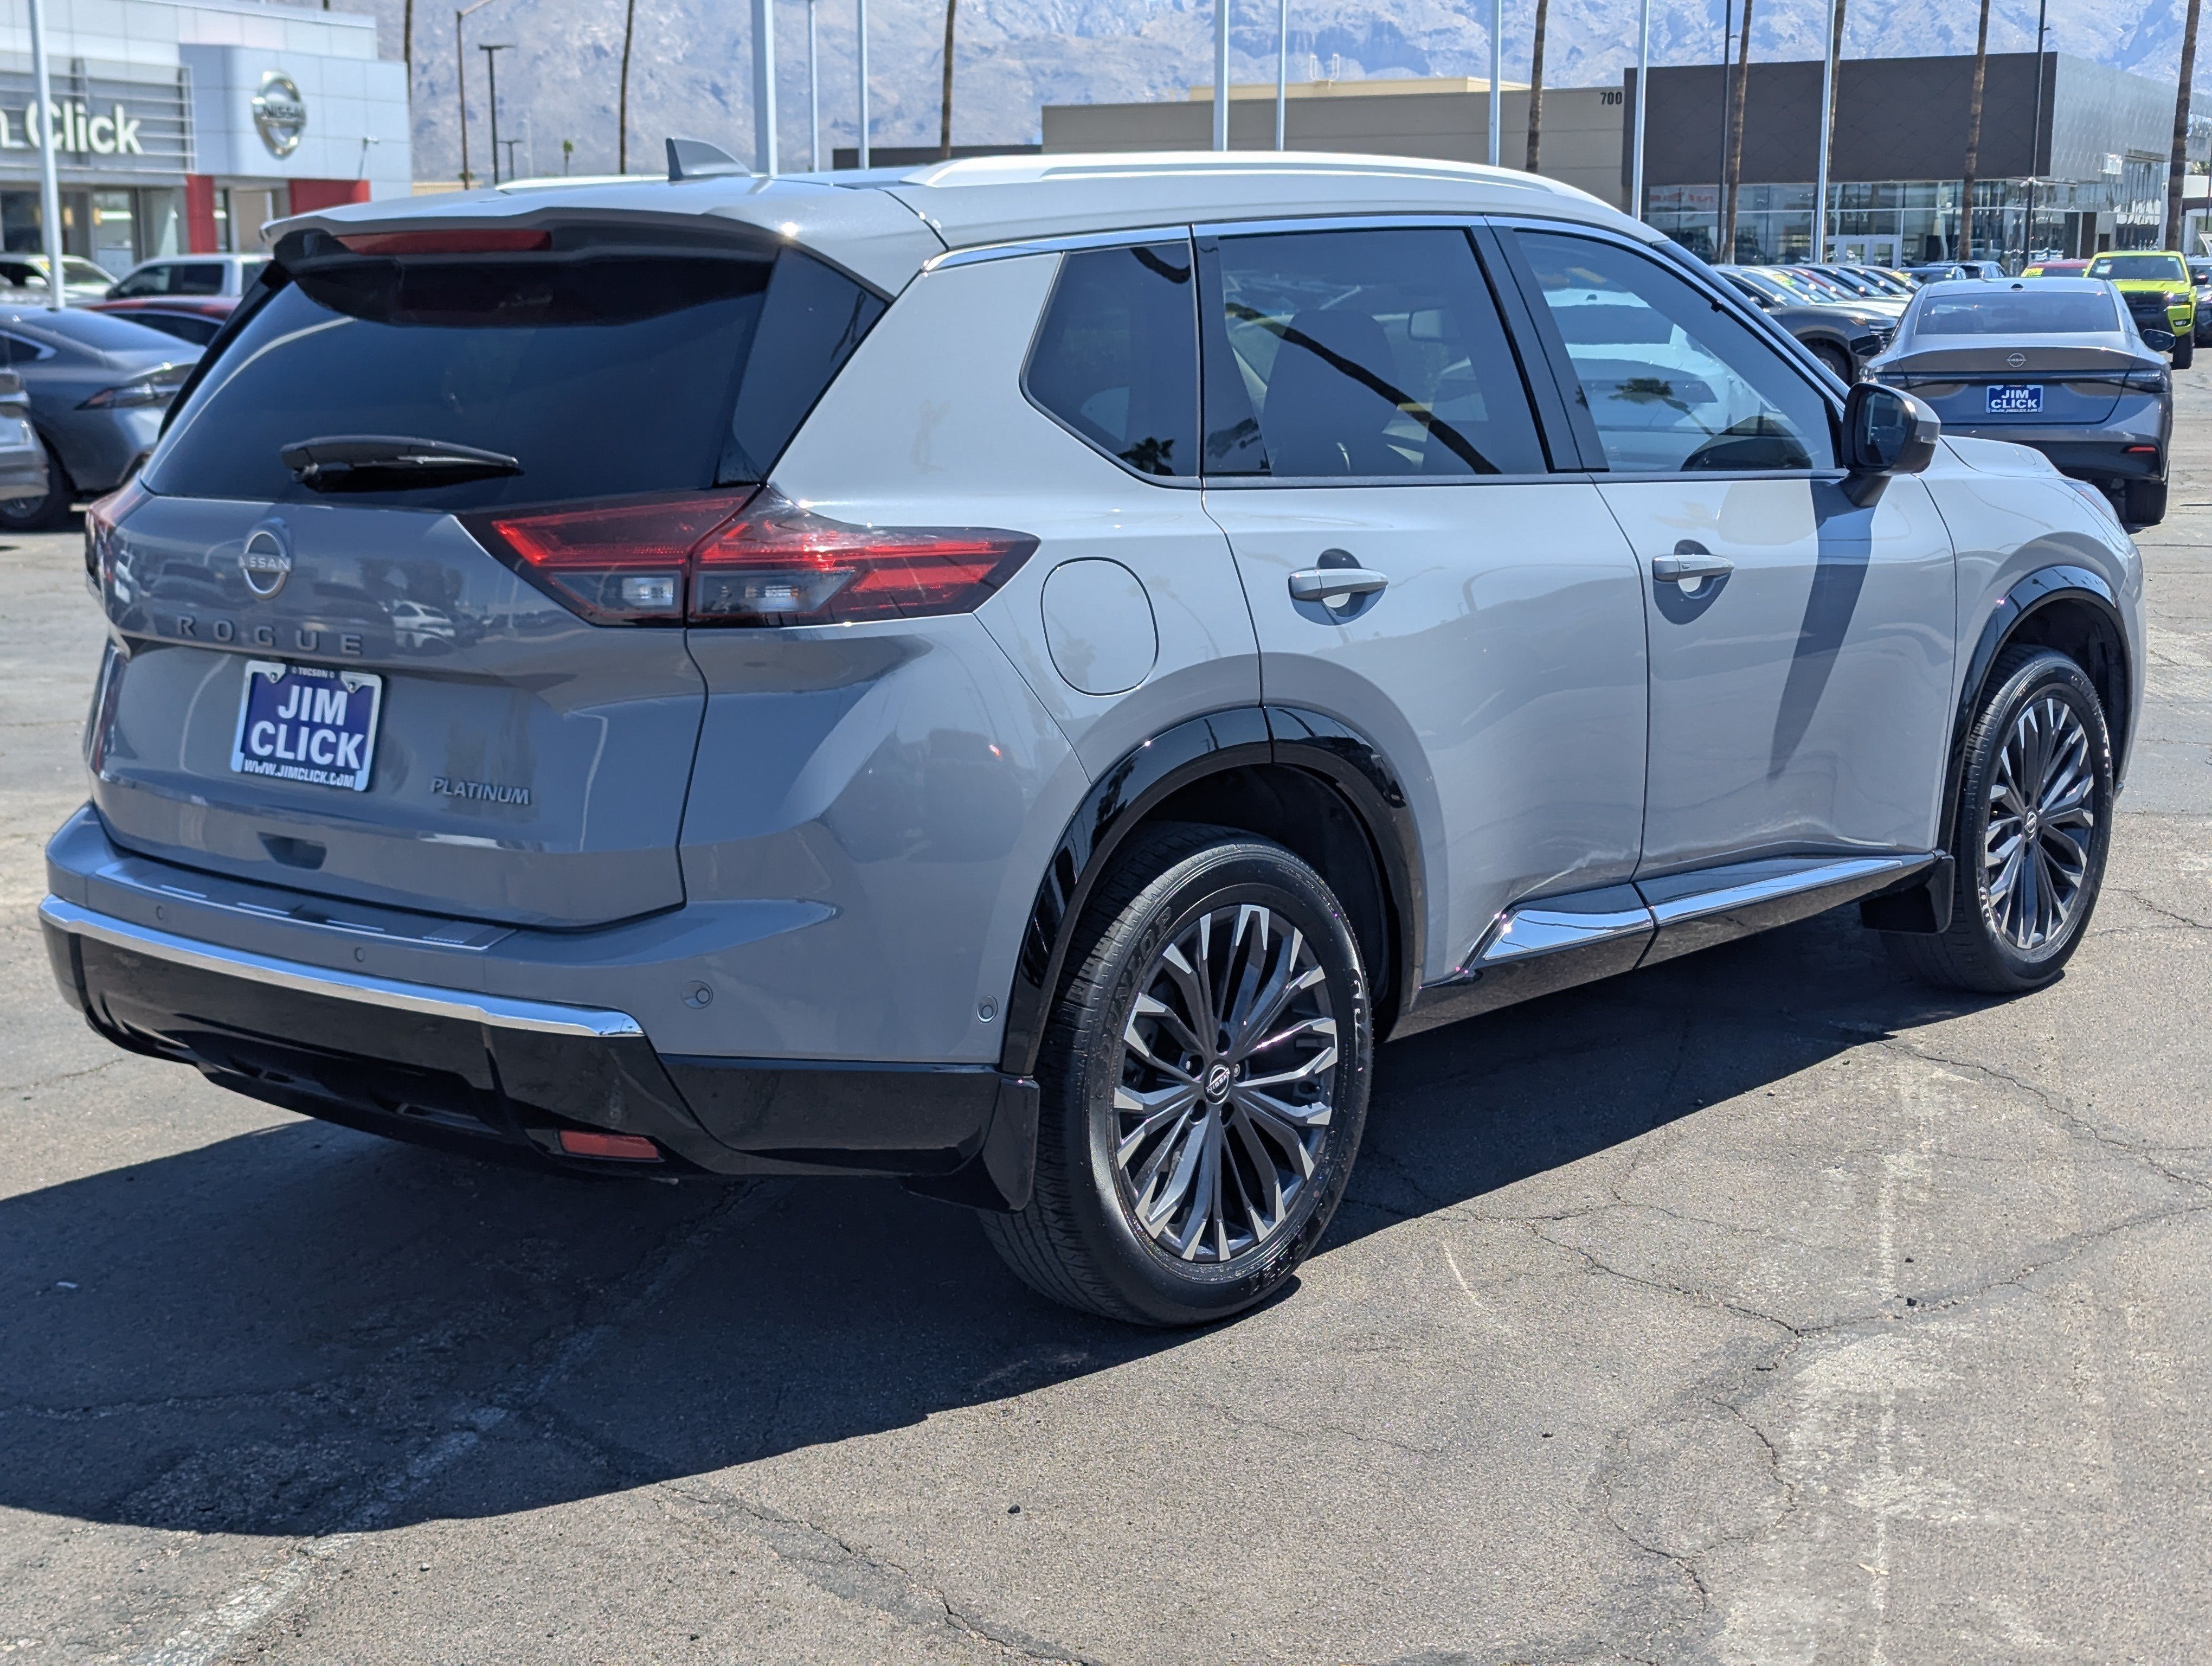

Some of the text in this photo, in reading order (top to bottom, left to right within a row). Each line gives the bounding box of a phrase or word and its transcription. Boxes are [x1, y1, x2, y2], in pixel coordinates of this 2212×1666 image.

[1600, 92, 1622, 105] 700
[25, 99, 144, 155] Click
[1991, 399, 2037, 408] CLICK
[2001, 389, 2029, 399] JIM
[239, 555, 291, 571] NSSAN
[176, 615, 364, 655] ROGUE
[298, 666, 328, 678] TUCSON
[278, 684, 348, 726] JIM
[250, 720, 364, 770] CLICK
[244, 759, 355, 788] WWW.JIMCLICK.COM
[430, 777, 529, 805] PLATINUM
